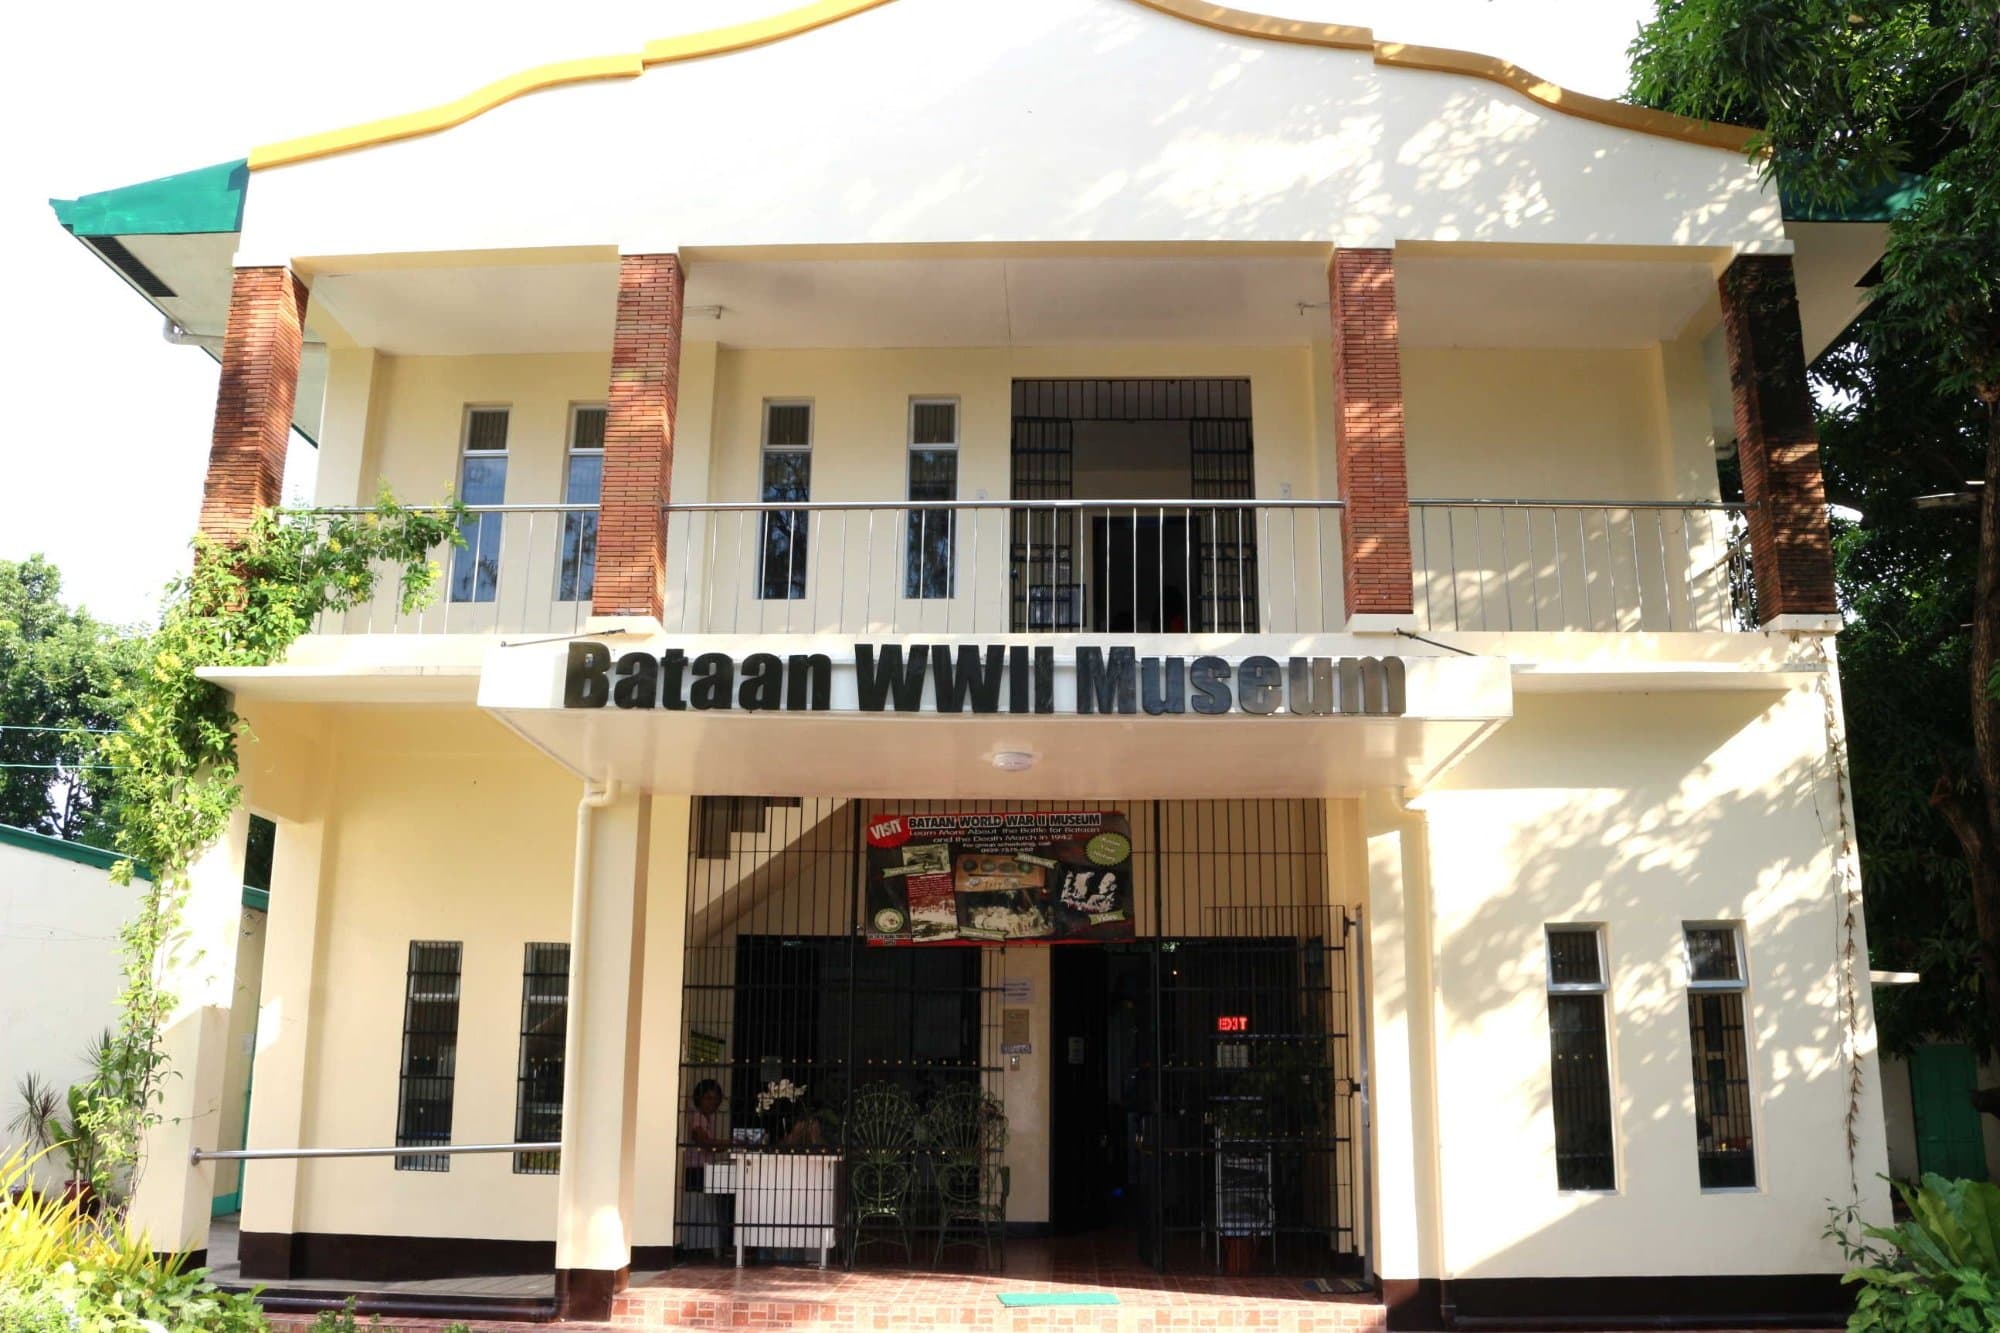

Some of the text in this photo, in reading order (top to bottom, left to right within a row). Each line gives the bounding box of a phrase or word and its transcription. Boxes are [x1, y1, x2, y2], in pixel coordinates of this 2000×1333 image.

[564, 642, 1406, 715] Bataan WWII Museum
[870, 819, 902, 840] VISIT
[908, 813, 1101, 829] BATAAN WORLD WAR II MUSEUM
[1217, 1017, 1248, 1031] EXIT
